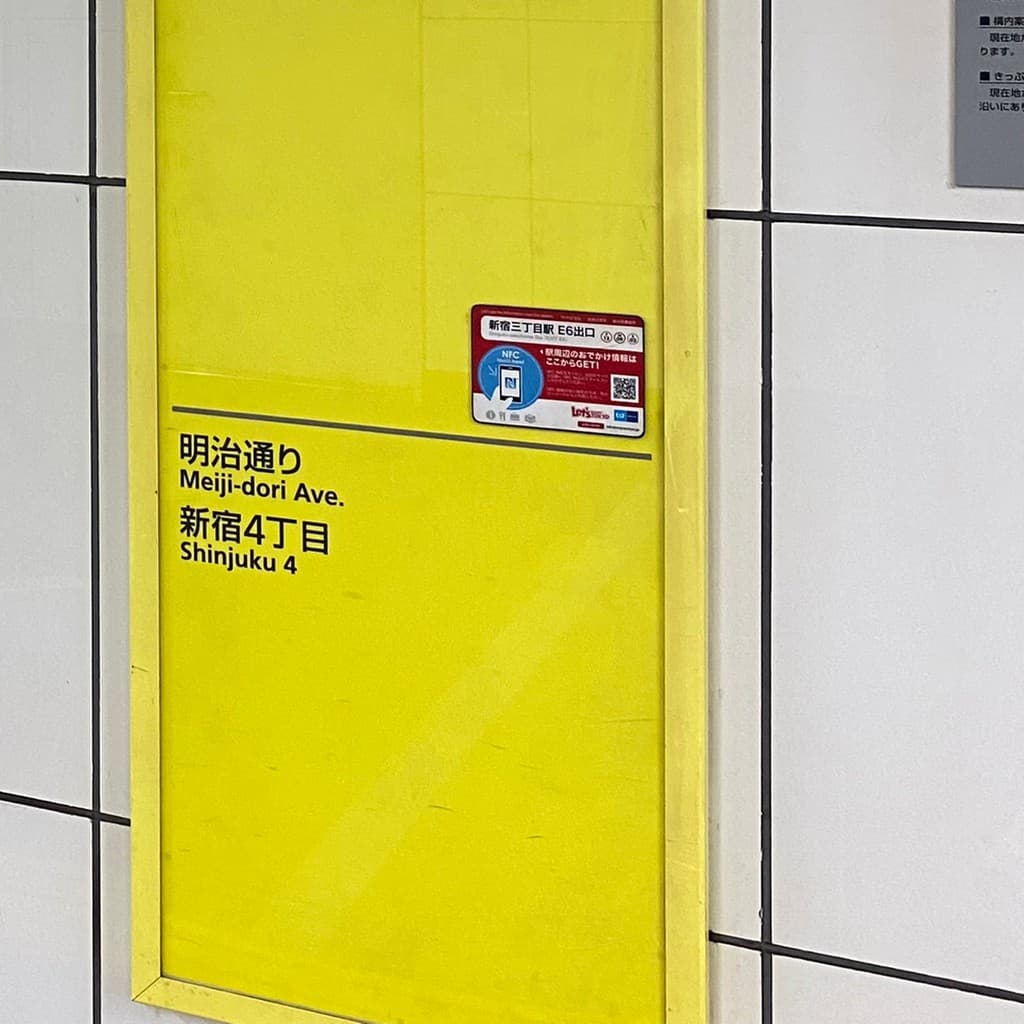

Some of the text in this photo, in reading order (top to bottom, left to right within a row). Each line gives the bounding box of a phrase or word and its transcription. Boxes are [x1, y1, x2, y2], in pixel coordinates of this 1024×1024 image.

[501, 349, 520, 360] NFC
[179, 433, 302, 475] 明治通り
[179, 469, 345, 507] Meiji-dori Ave.
[179, 505, 329, 555] 新宿4丁目
[180, 541, 297, 575] Shinjuku 4
